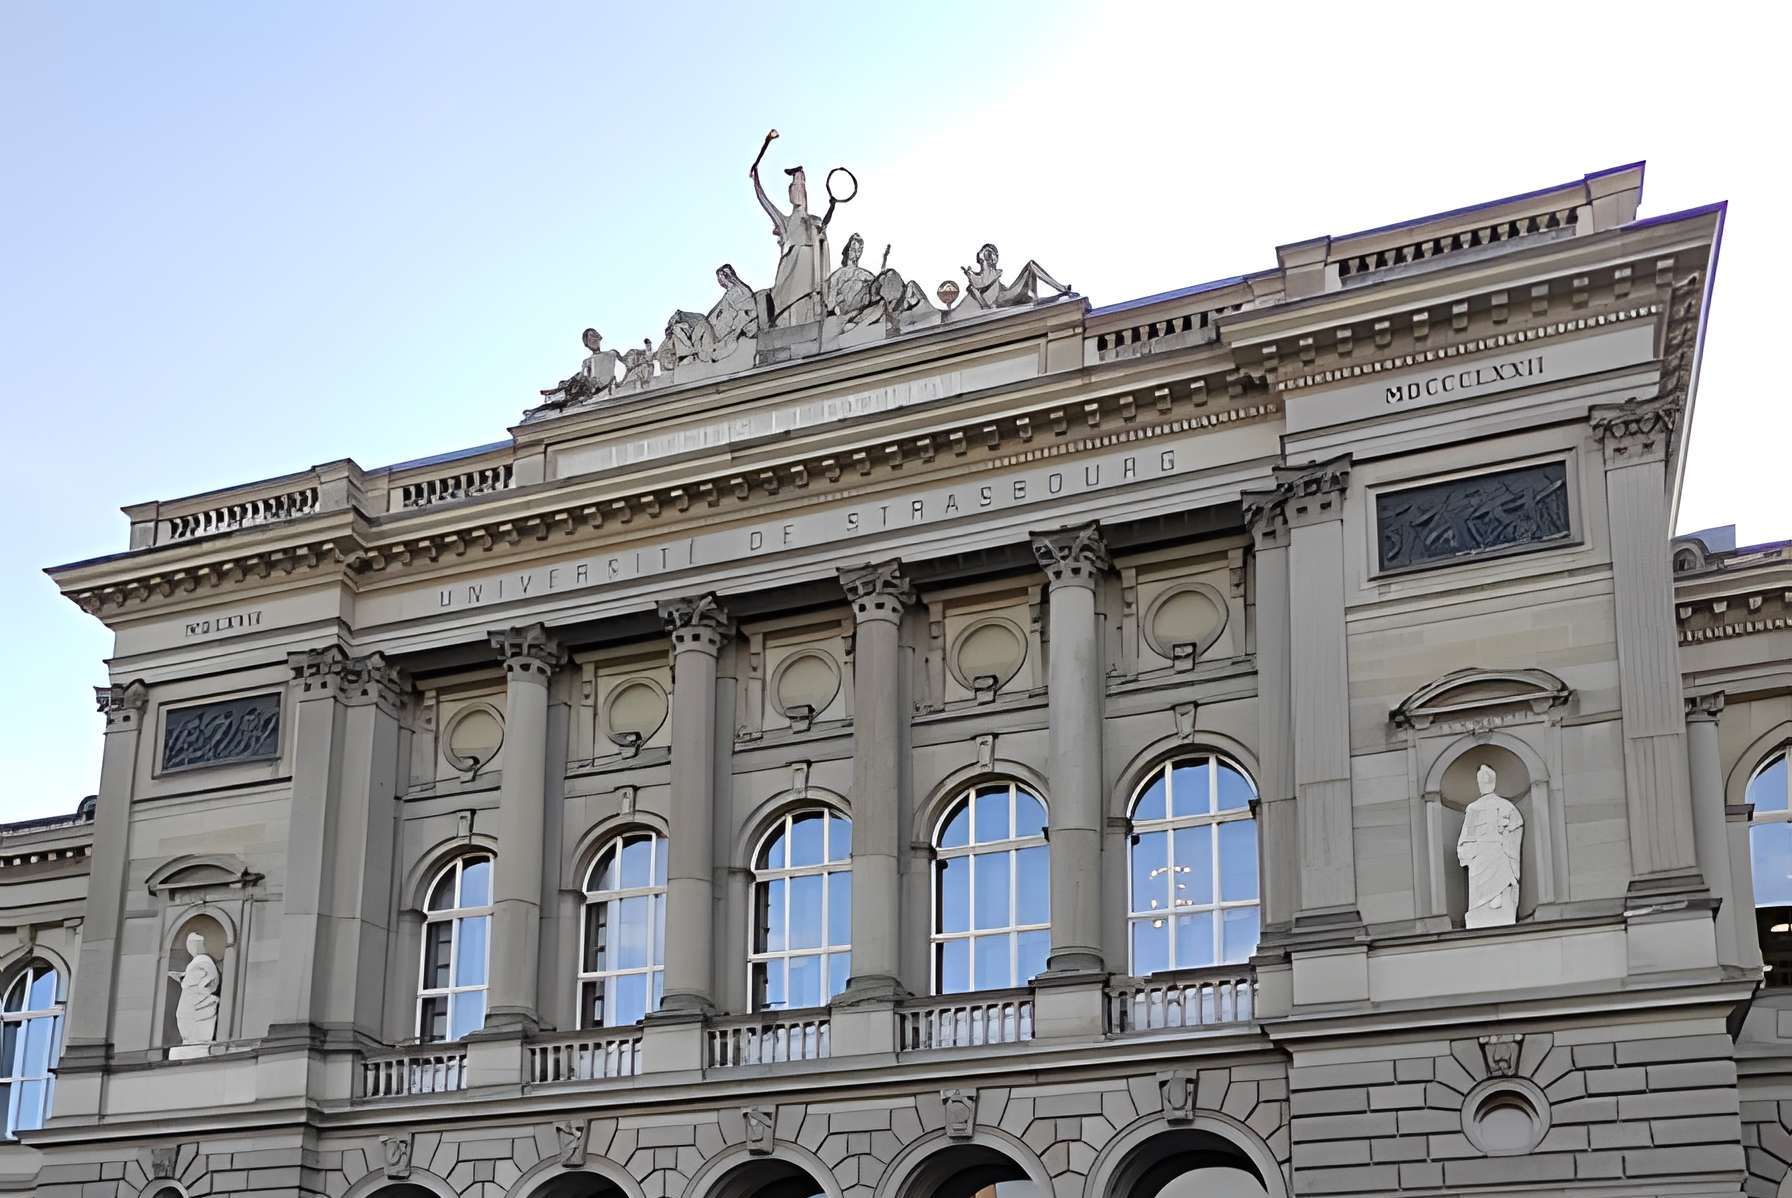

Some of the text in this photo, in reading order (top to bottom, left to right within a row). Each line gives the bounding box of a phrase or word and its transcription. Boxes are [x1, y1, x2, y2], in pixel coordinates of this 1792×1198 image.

[1385, 356, 1544, 404] MDCCCLXXII
[750, 524, 795, 551] DE
[846, 450, 1175, 532] STRASBOURG
